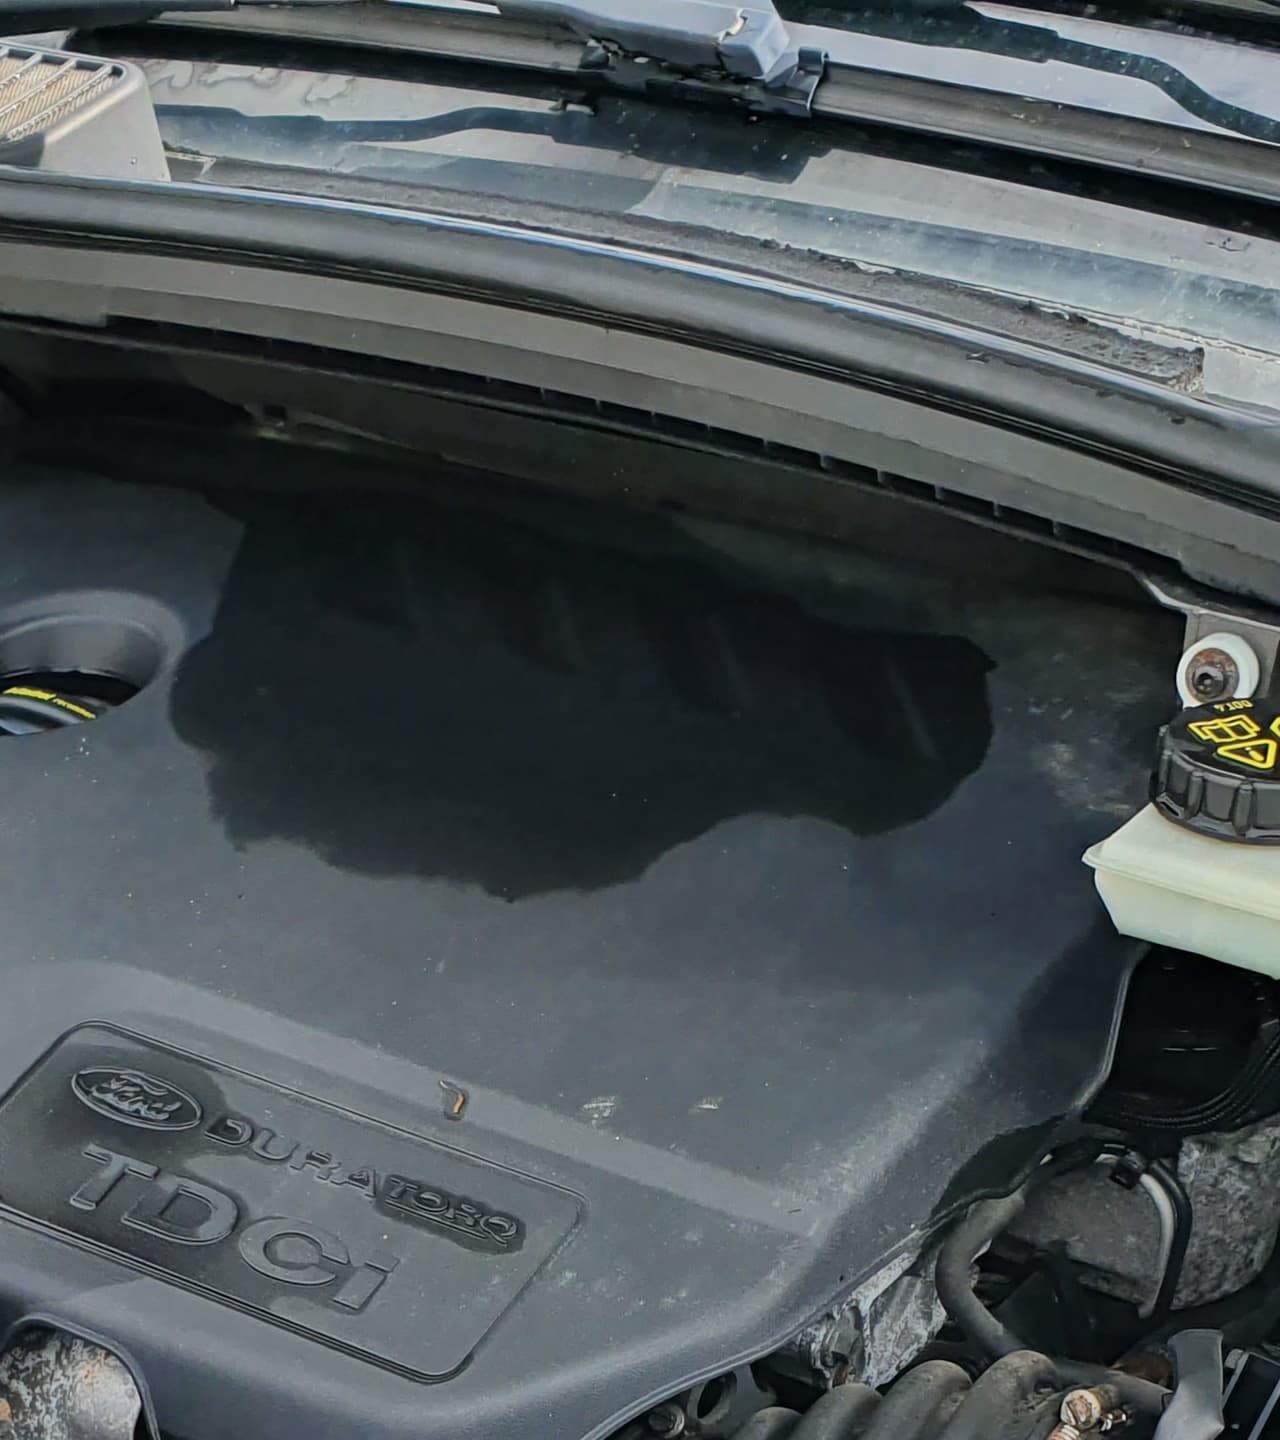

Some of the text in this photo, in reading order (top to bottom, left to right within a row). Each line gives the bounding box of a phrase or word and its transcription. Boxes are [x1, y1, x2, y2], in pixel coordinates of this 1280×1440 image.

[91, 1076, 183, 1121] Ford
[69, 1143, 402, 1311] TDCi
[203, 1117, 518, 1246] DURATORQ
